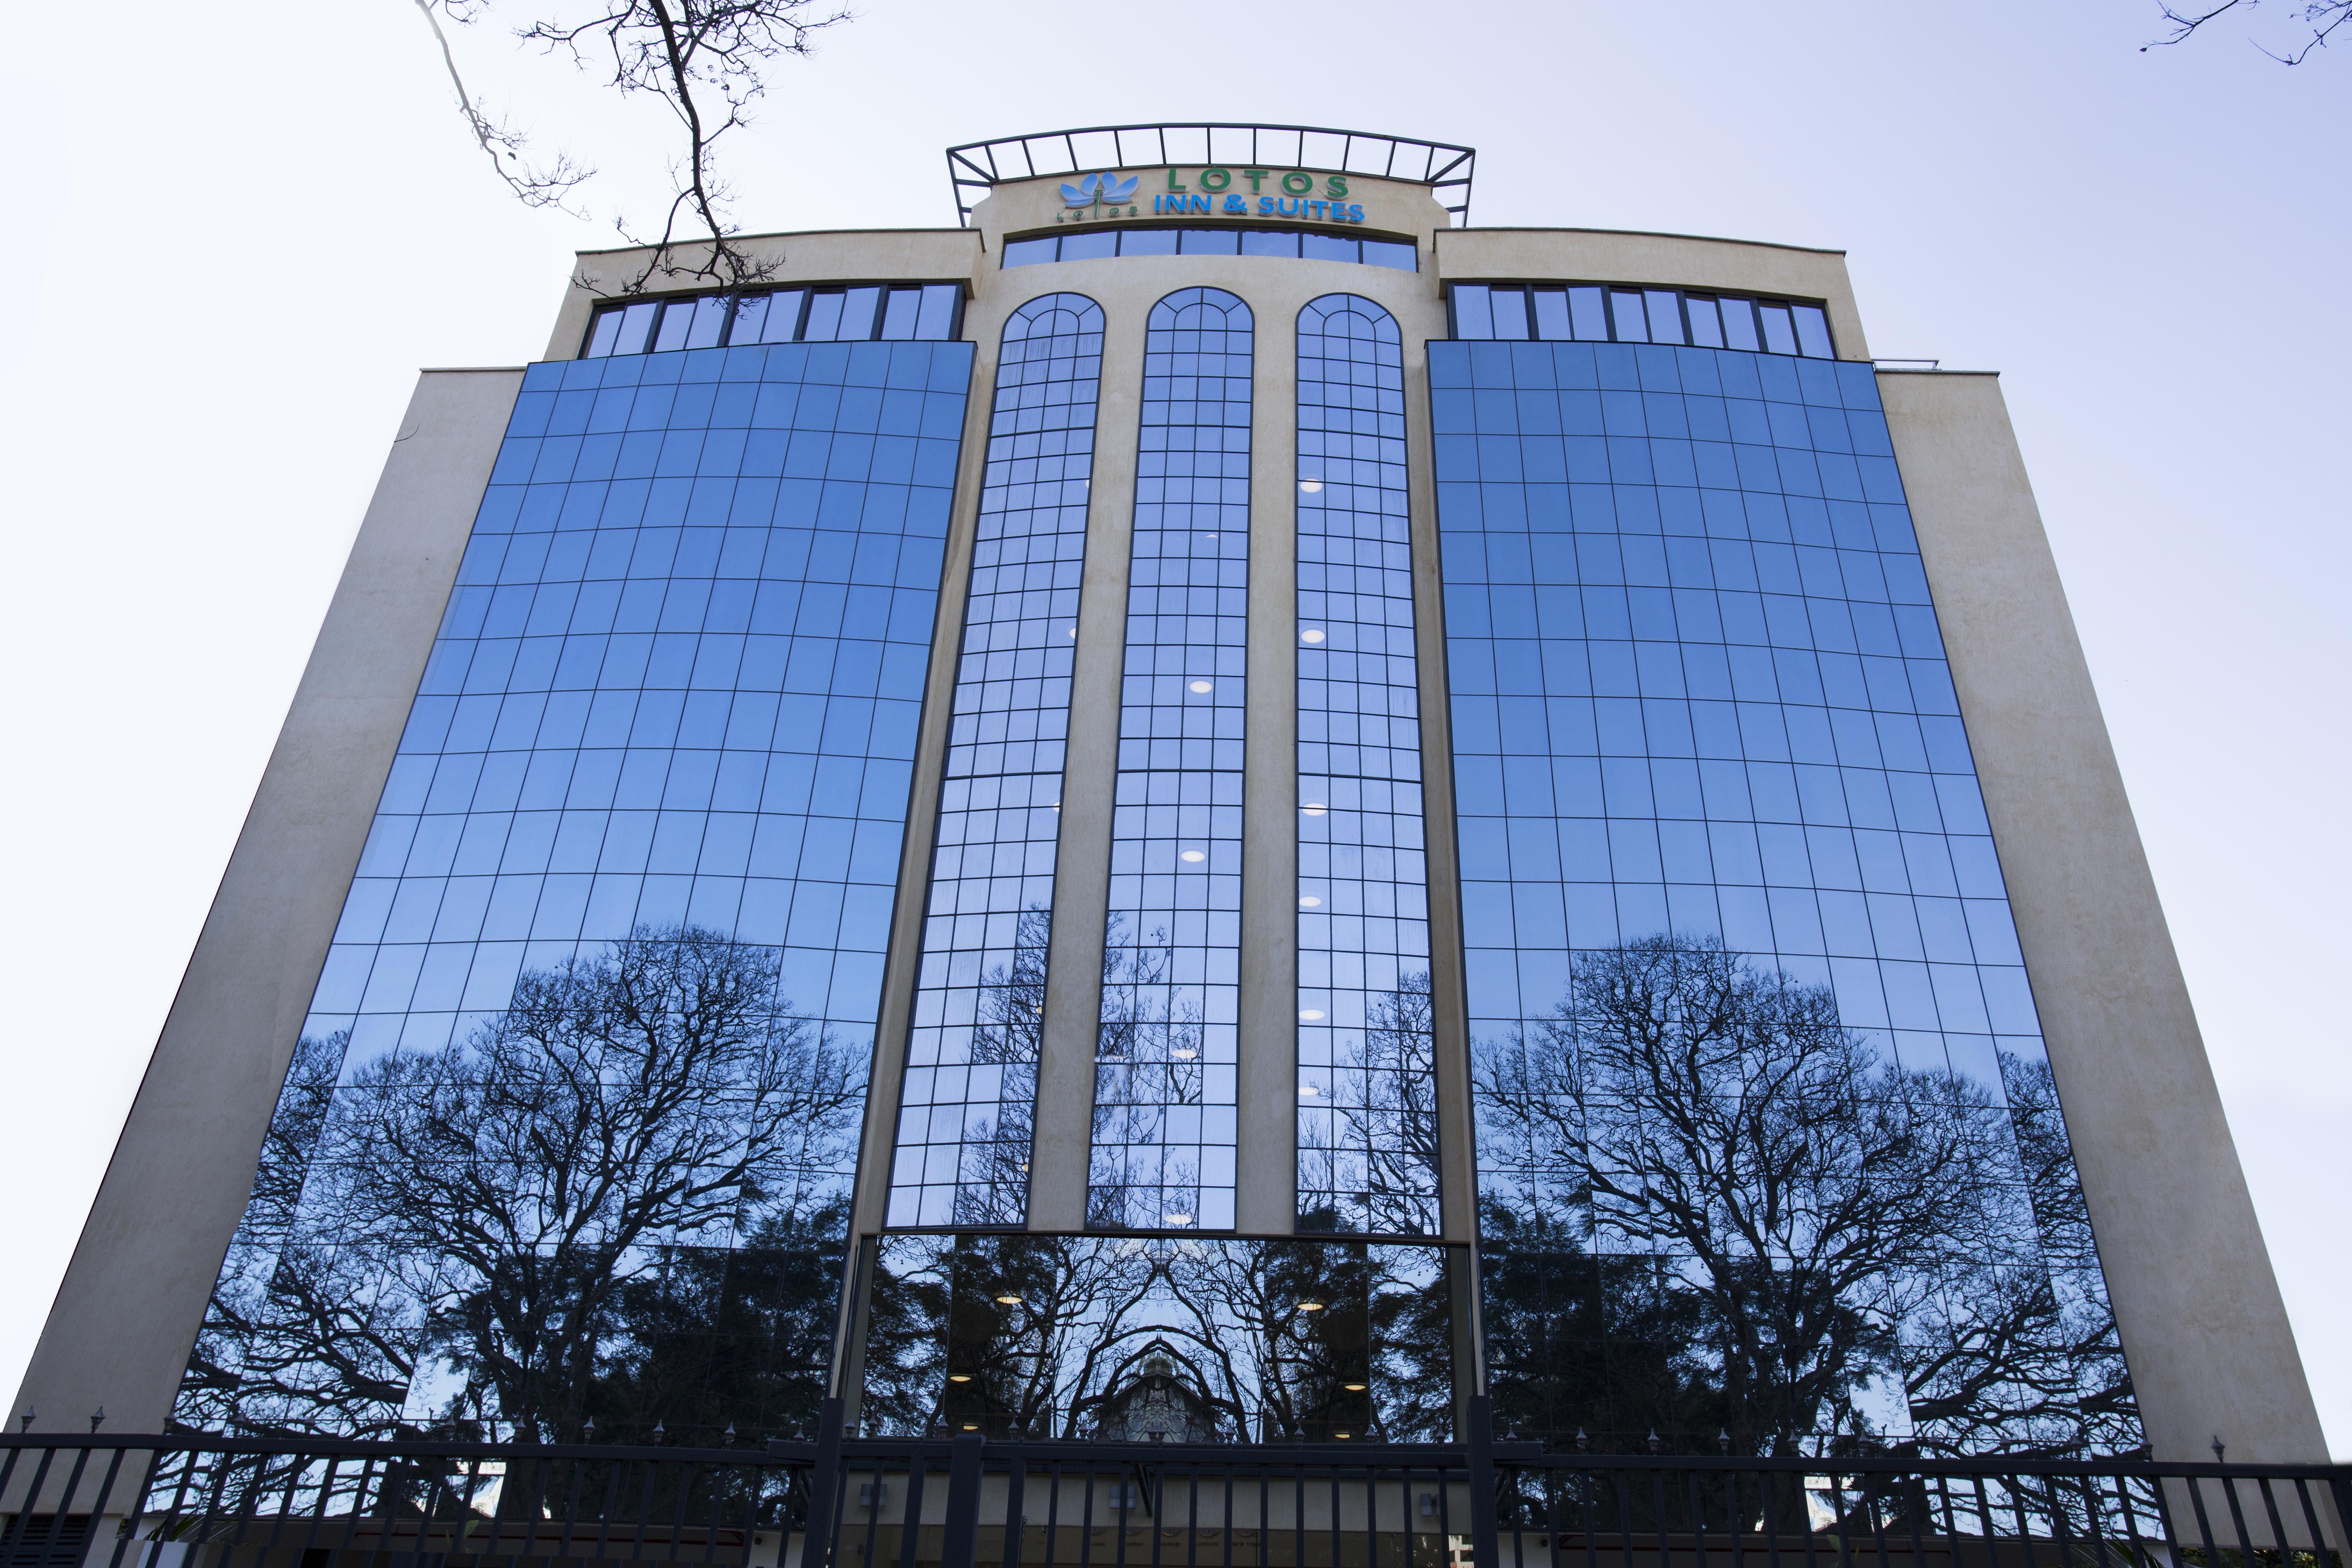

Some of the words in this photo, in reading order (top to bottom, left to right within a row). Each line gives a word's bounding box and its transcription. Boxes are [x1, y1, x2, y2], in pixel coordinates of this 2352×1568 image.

[1168, 168, 1348, 199] LOTOS
[1056, 189, 1138, 221] LOTOS
[1155, 194, 1212, 214] INN
[1223, 194, 1248, 215] &
[1258, 196, 1365, 224] SUITES
